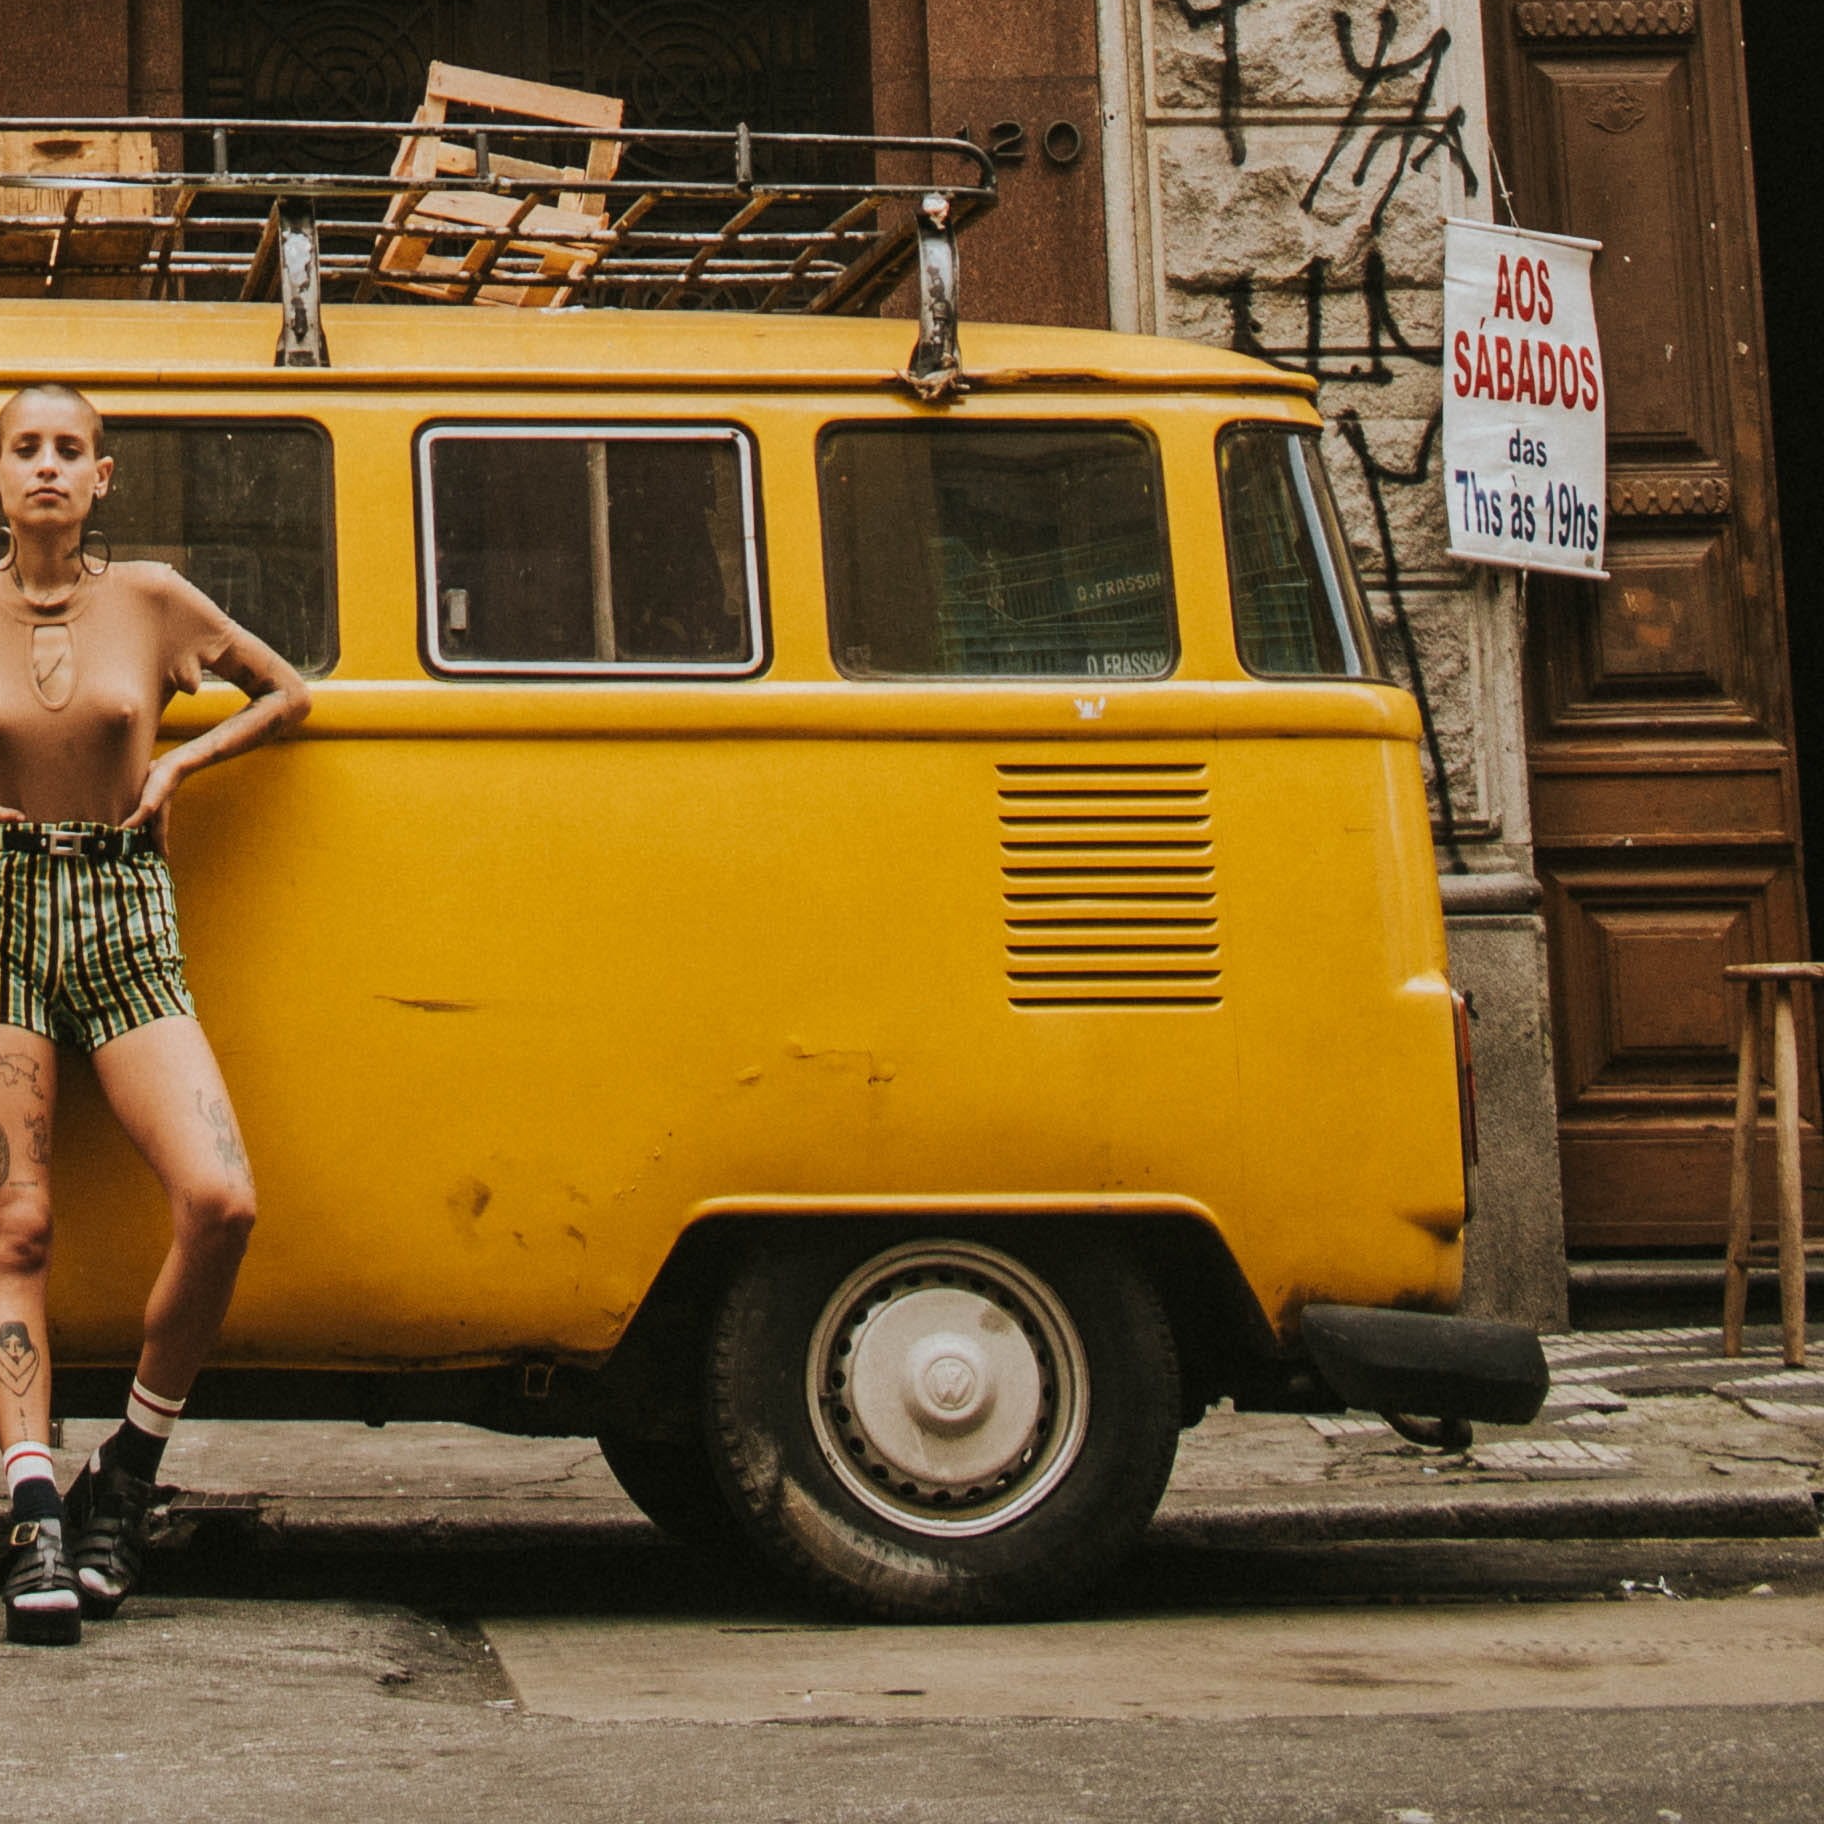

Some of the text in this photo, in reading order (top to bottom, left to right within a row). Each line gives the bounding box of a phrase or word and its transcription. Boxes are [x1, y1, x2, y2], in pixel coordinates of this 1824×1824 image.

[1494, 254, 1554, 326] AOS
[1453, 316, 1600, 412] SÁBADOS
[1509, 428, 1547, 468] das
[1455, 469, 1599, 552] 7hs às 19hs
